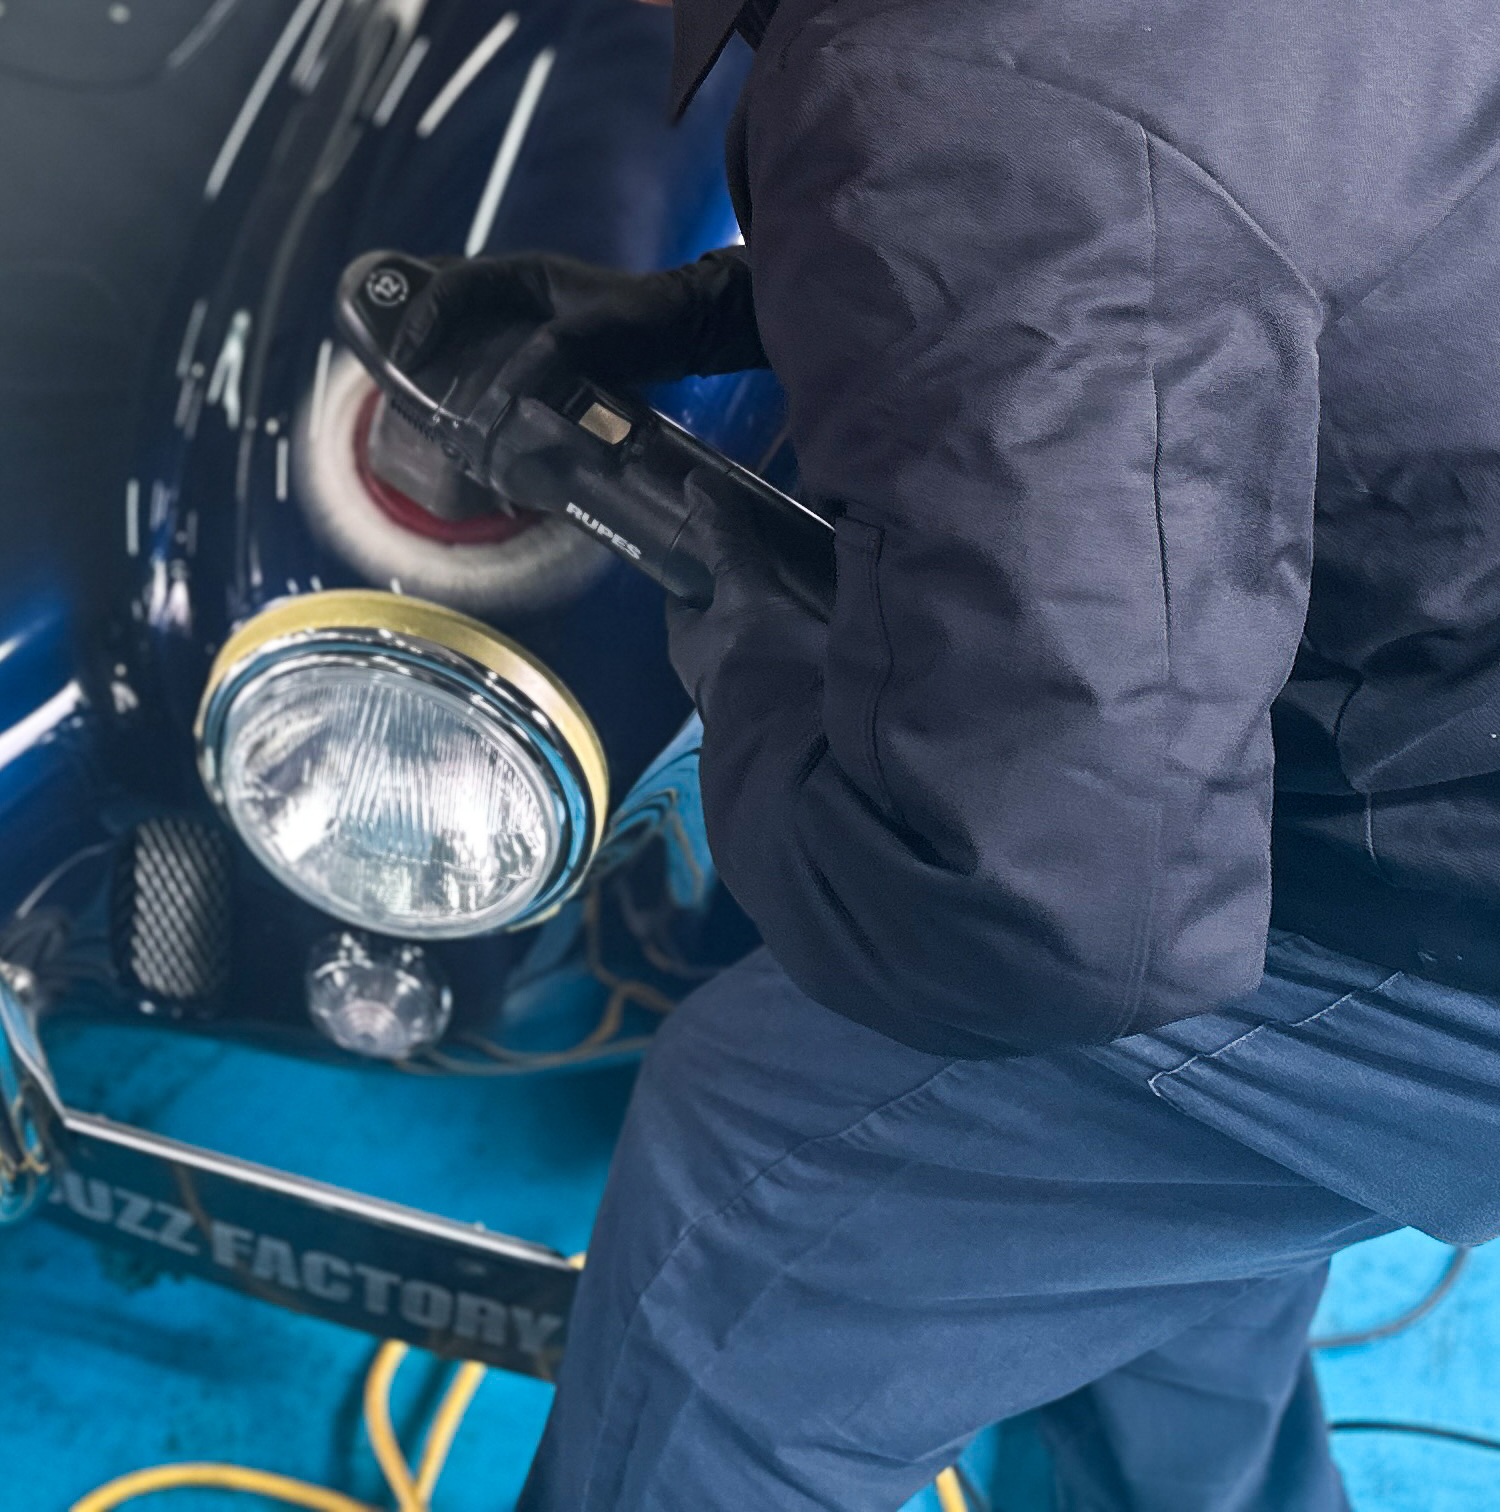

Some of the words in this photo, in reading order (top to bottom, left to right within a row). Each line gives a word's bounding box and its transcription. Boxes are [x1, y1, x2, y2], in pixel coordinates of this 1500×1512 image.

[375, 276, 400, 298] 12
[566, 502, 641, 559] RUPES
[48, 1170, 200, 1256] UZZ
[210, 1221, 563, 1356] FACTORY
